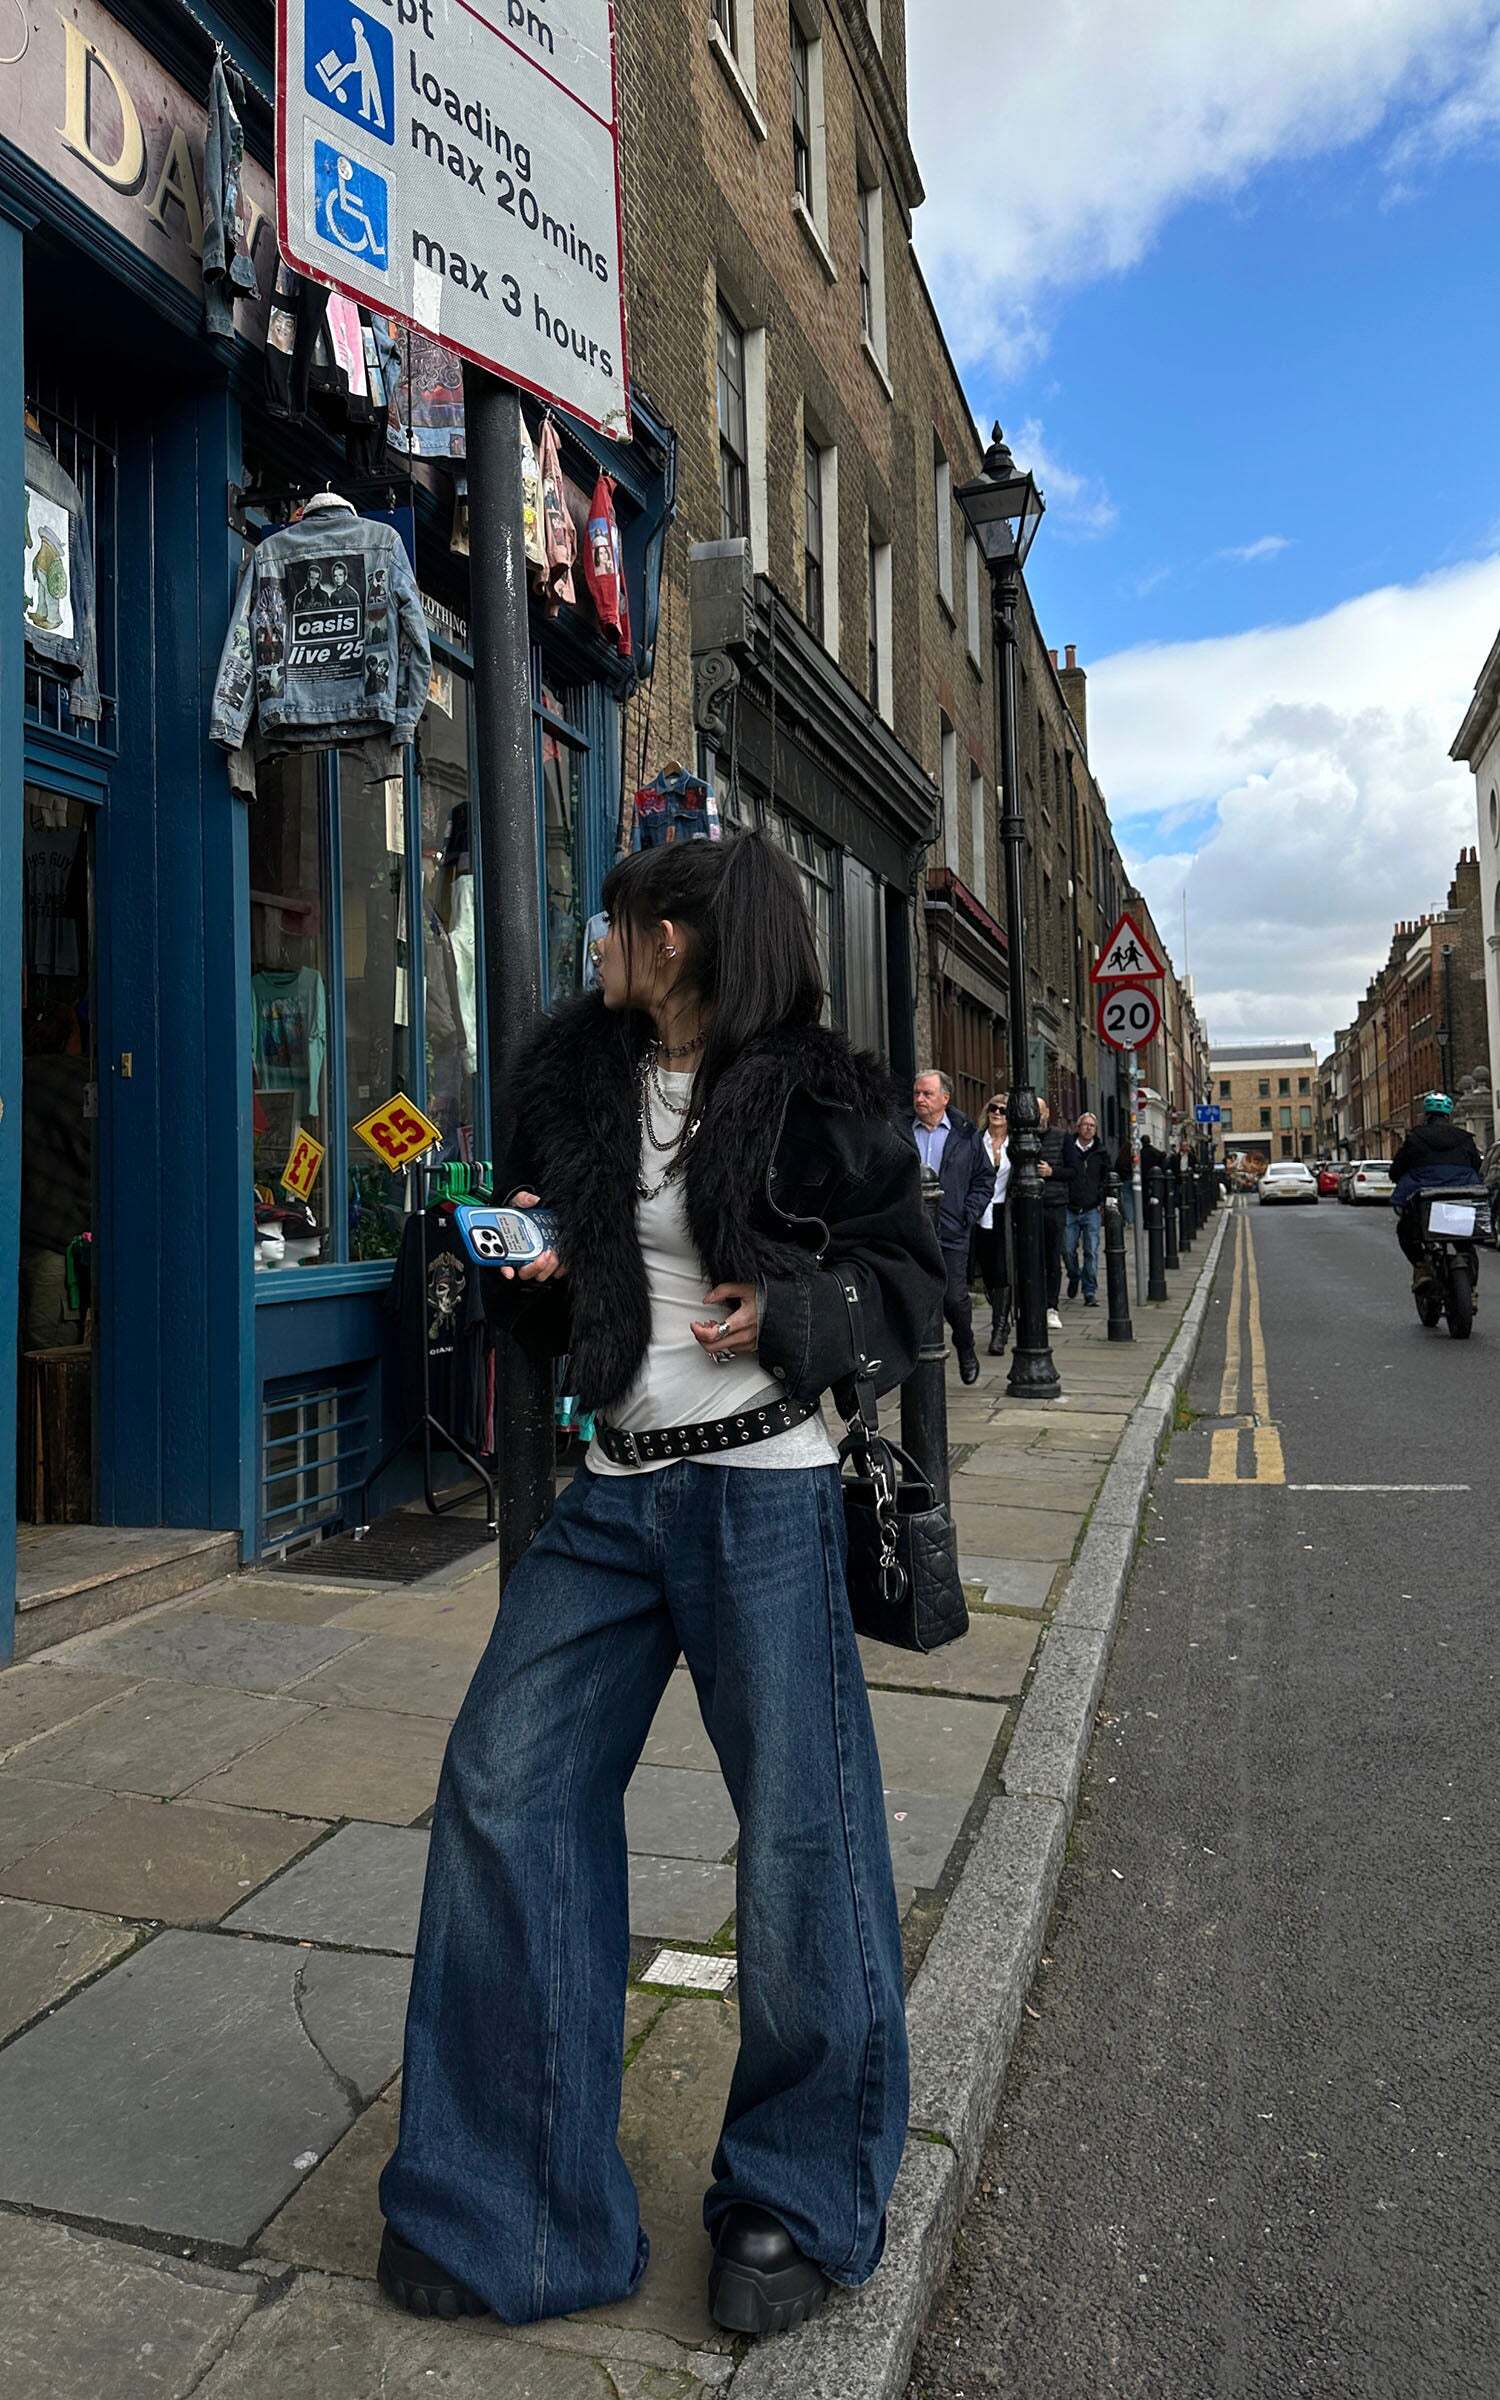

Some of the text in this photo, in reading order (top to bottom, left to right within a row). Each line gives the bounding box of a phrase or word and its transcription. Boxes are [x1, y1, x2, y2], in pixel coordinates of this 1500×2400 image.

[410, 49, 531, 182] loading
[411, 117, 608, 283] max 20mins
[412, 229, 613, 377] max 3 hours
[298, 614, 355, 636] oasis
[288, 641, 364, 665] live '25
[1107, 1003, 1150, 1031] 20
[371, 1108, 426, 1158] £5
[288, 1142, 319, 1192] £1
